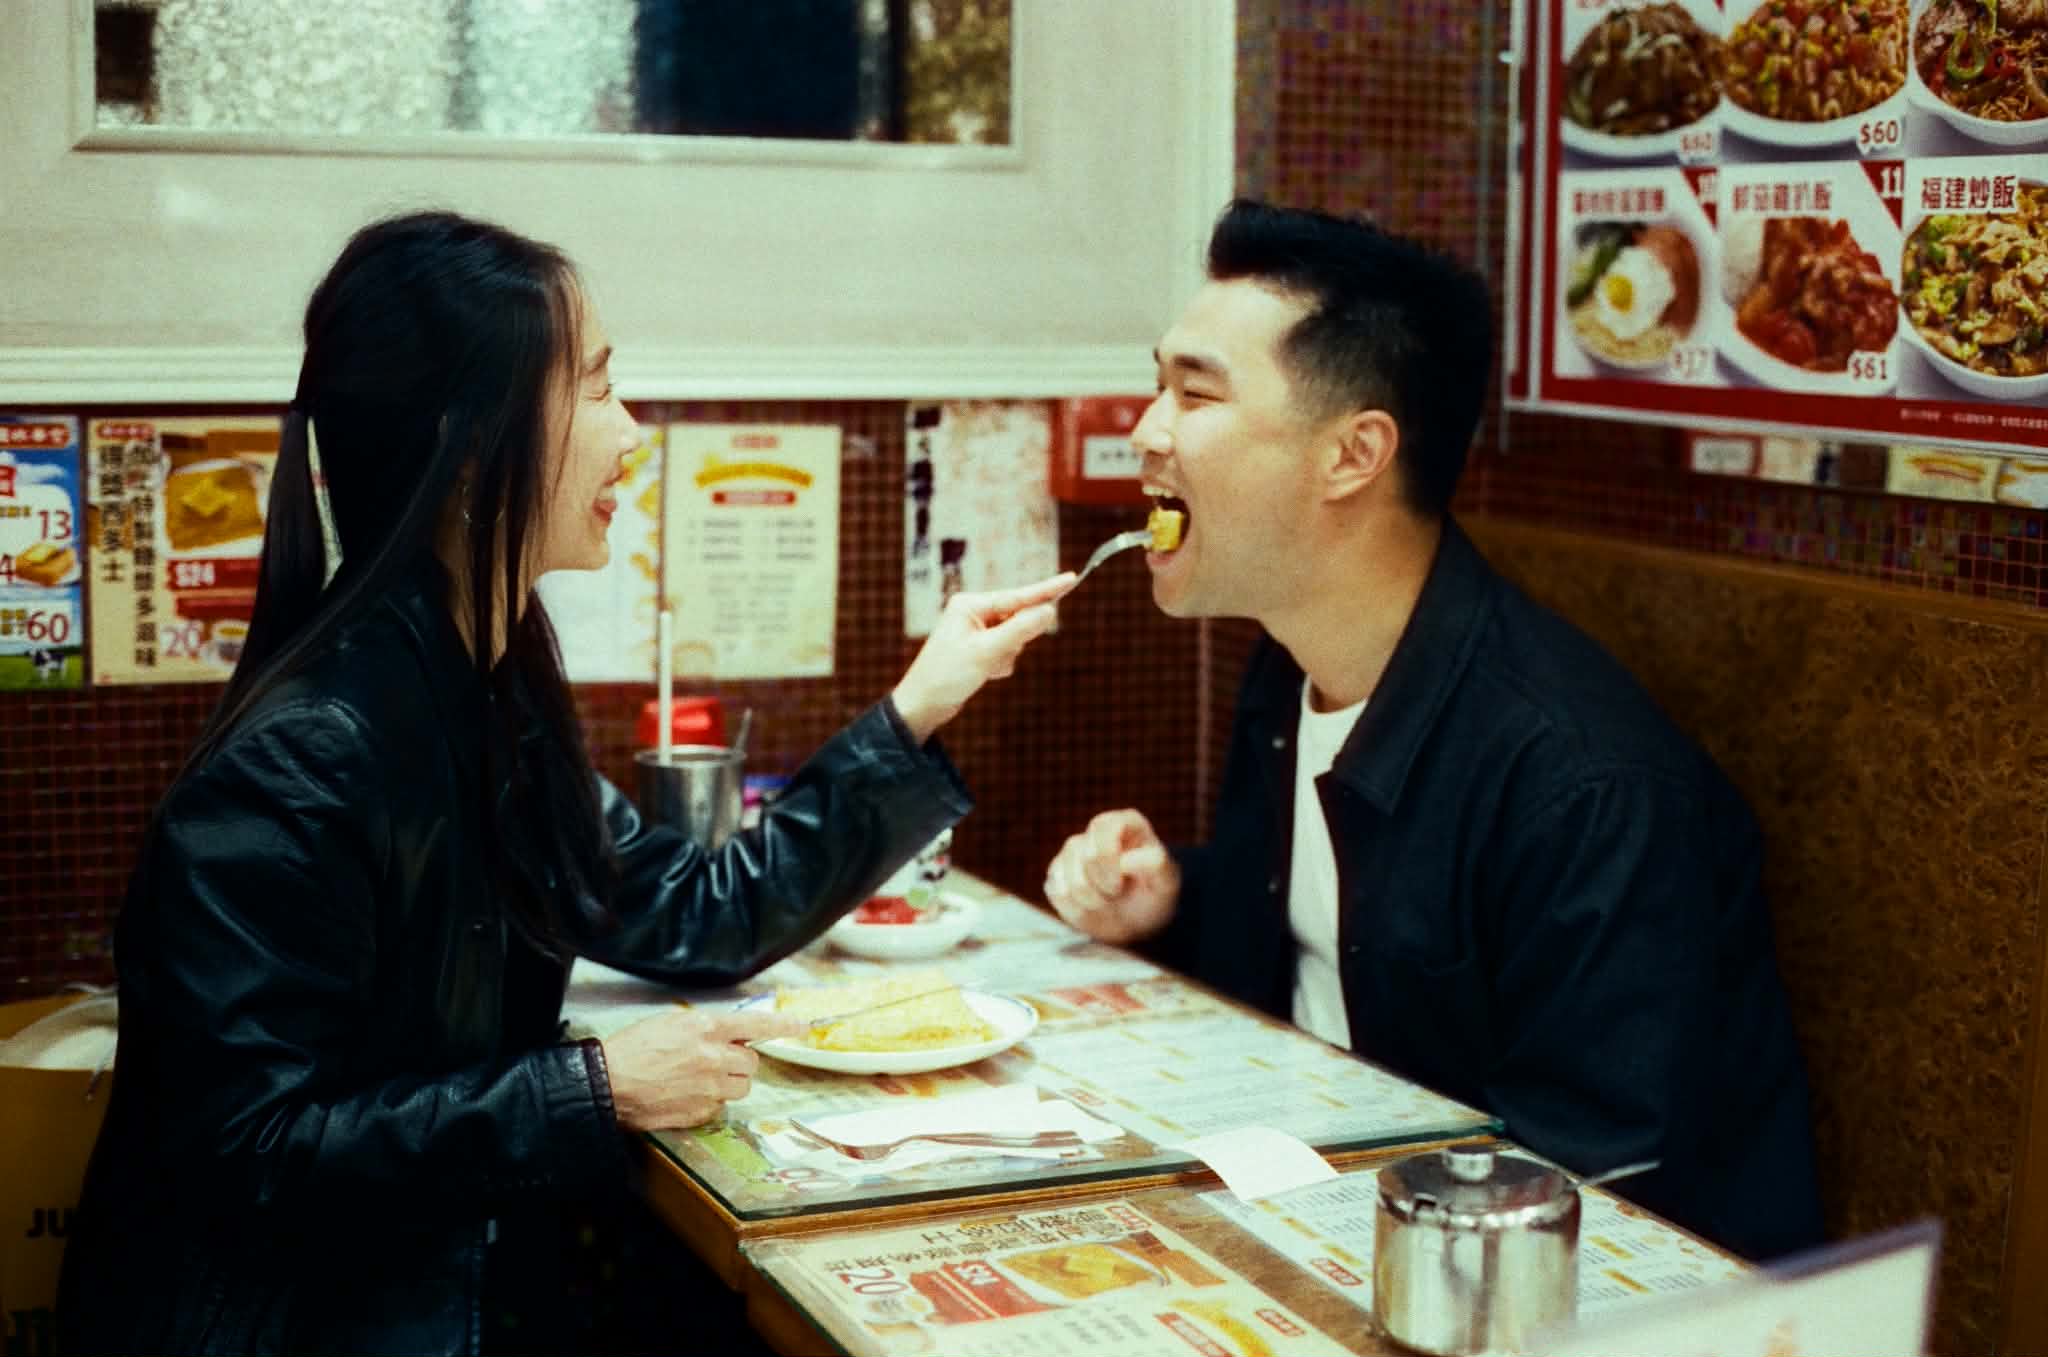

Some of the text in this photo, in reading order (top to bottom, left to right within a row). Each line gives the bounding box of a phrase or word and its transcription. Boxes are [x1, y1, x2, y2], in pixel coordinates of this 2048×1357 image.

[1860, 120, 1898, 146] $60
[1881, 167, 1904, 198] 11
[1920, 176, 2017, 209] 福建炒飯
[1852, 357, 1887, 380] $61
[37, 509, 71, 540] 13
[174, 562, 214, 588] $24
[26, 611, 69, 643] 60
[837, 1267, 908, 1295] 20
